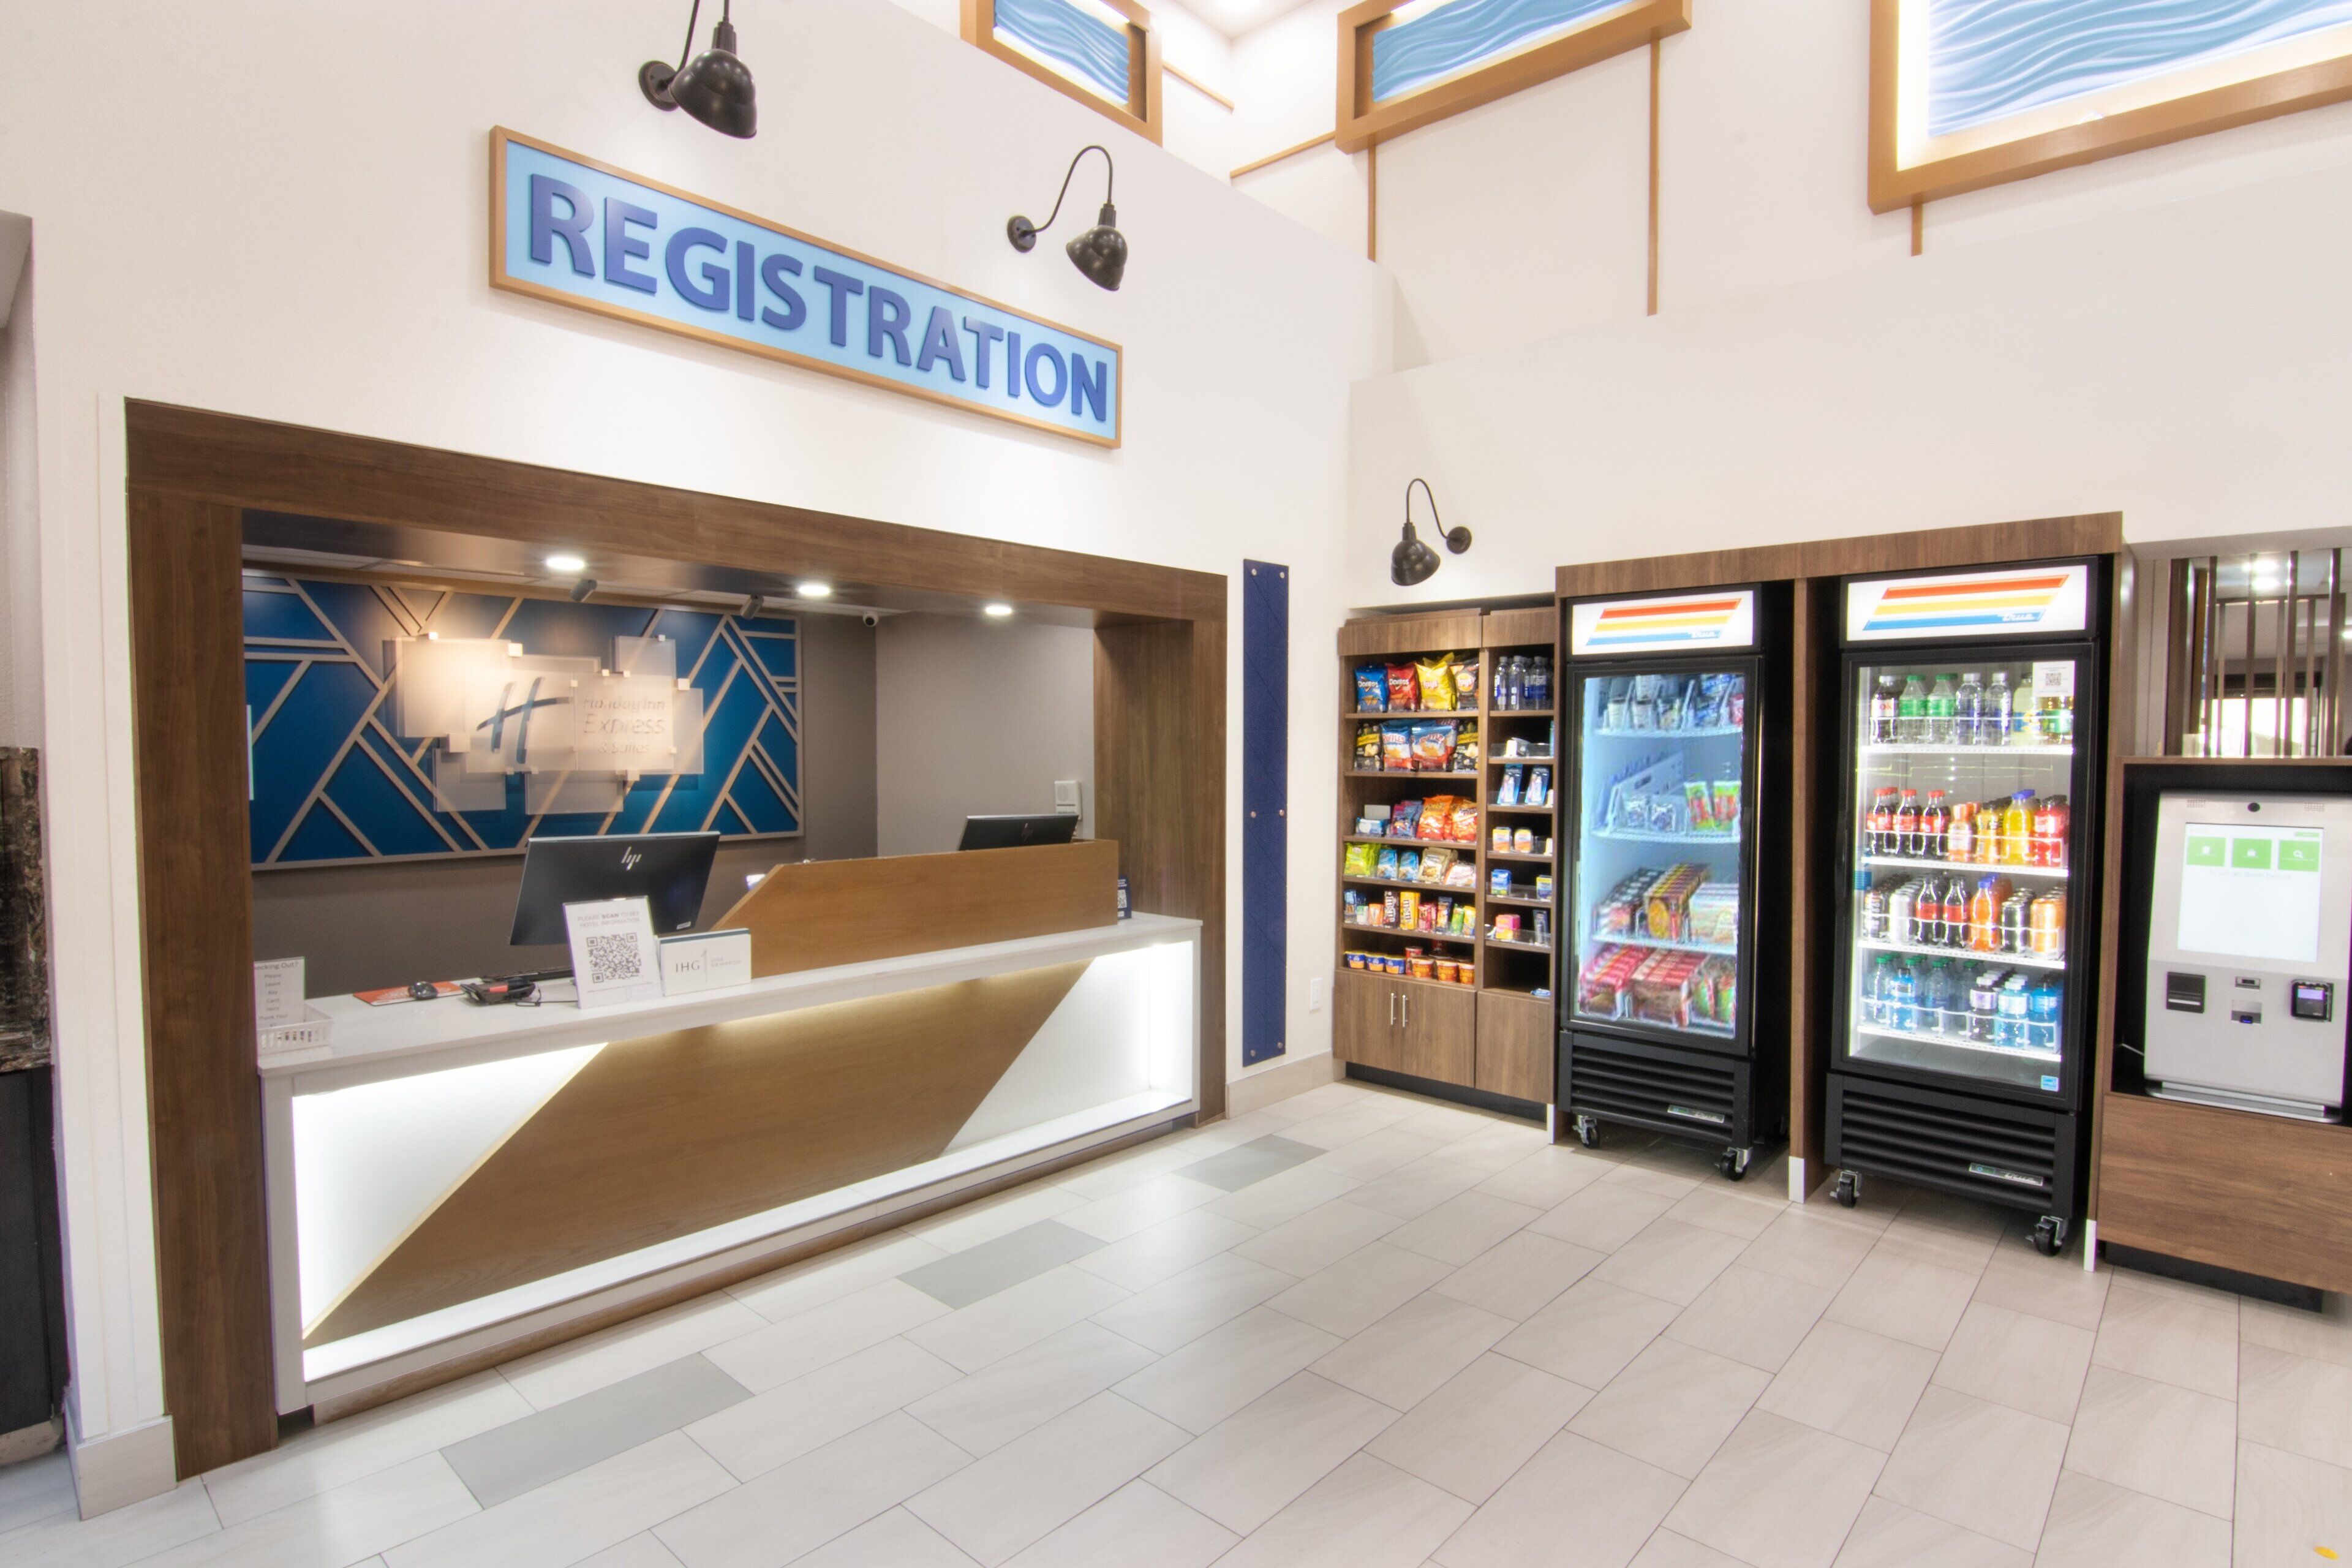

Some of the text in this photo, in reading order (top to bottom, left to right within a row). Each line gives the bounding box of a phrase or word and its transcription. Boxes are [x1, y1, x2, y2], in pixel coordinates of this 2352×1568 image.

[529, 173, 1108, 423] REGISTRATION
[584, 713, 666, 734] Express
[676, 960, 700, 973] IHG
